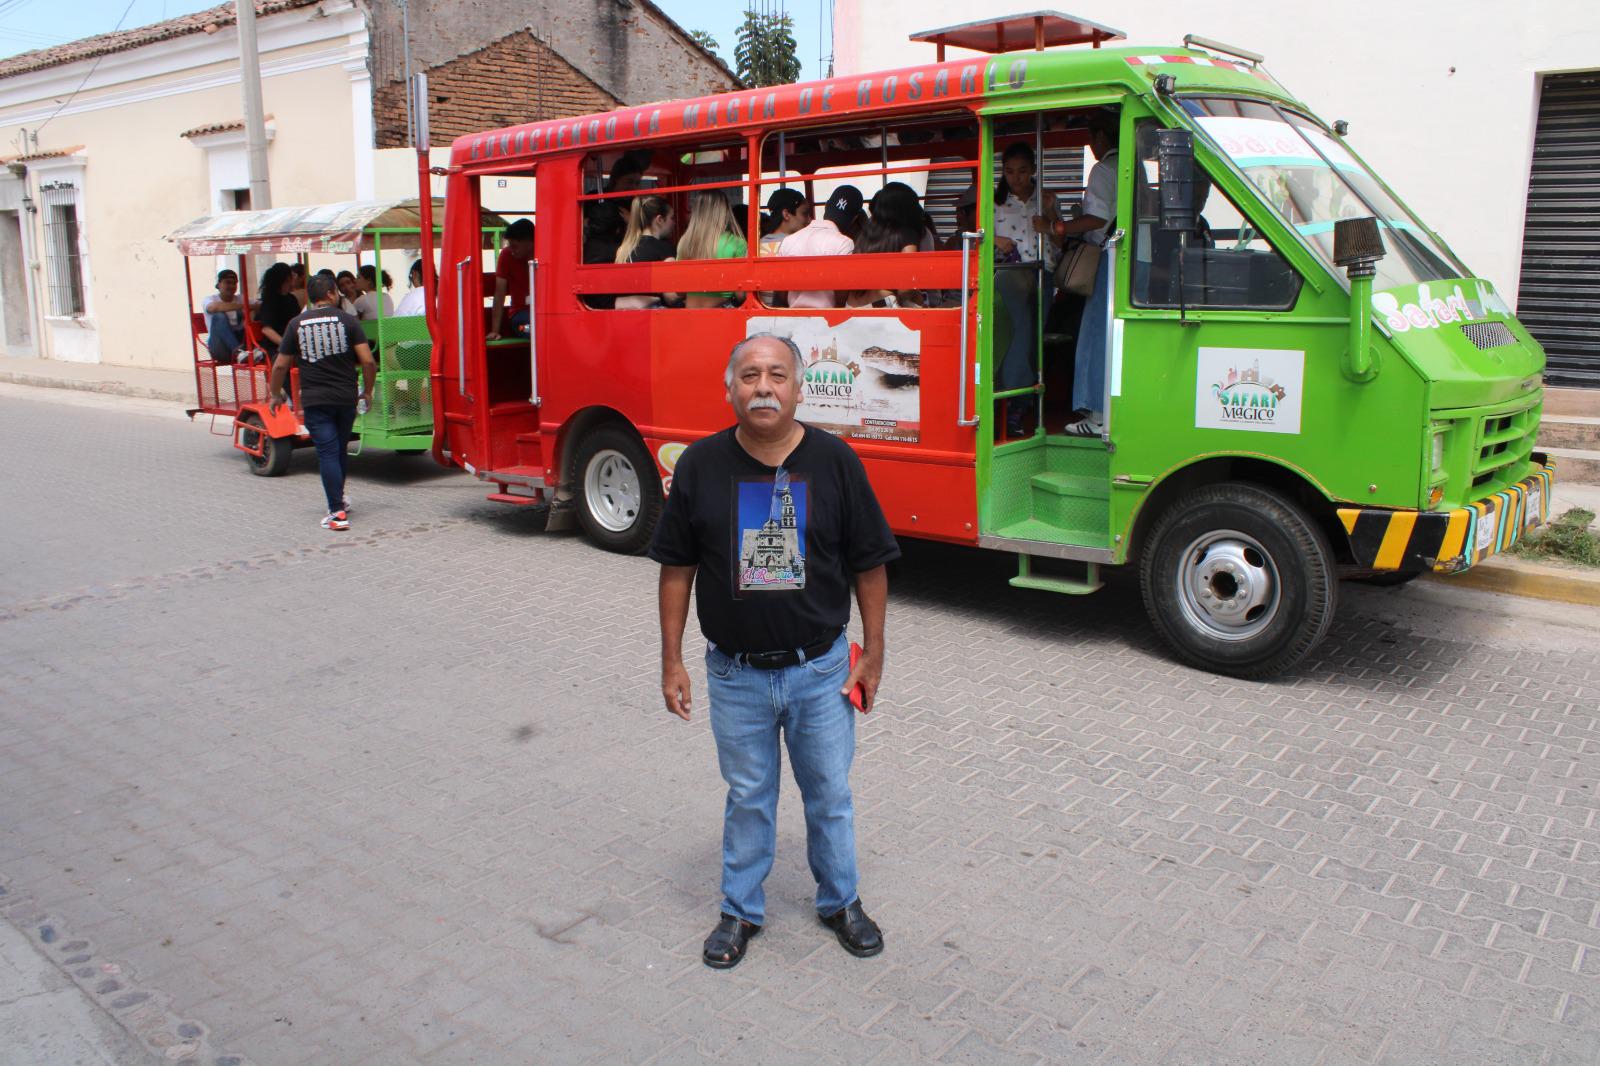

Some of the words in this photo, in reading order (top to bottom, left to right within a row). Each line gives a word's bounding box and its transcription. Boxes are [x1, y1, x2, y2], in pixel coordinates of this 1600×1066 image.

[471, 116, 617, 160] CONOCIENDO
[633, 109, 662, 137] LA
[682, 93, 777, 129] MAGIA
[797, 84, 835, 115] DE
[857, 58, 1028, 108] ROSARIO
[1371, 283, 1474, 333] Safari
[804, 367, 854, 385] SAFARI
[1220, 390, 1278, 409] SAFARI
